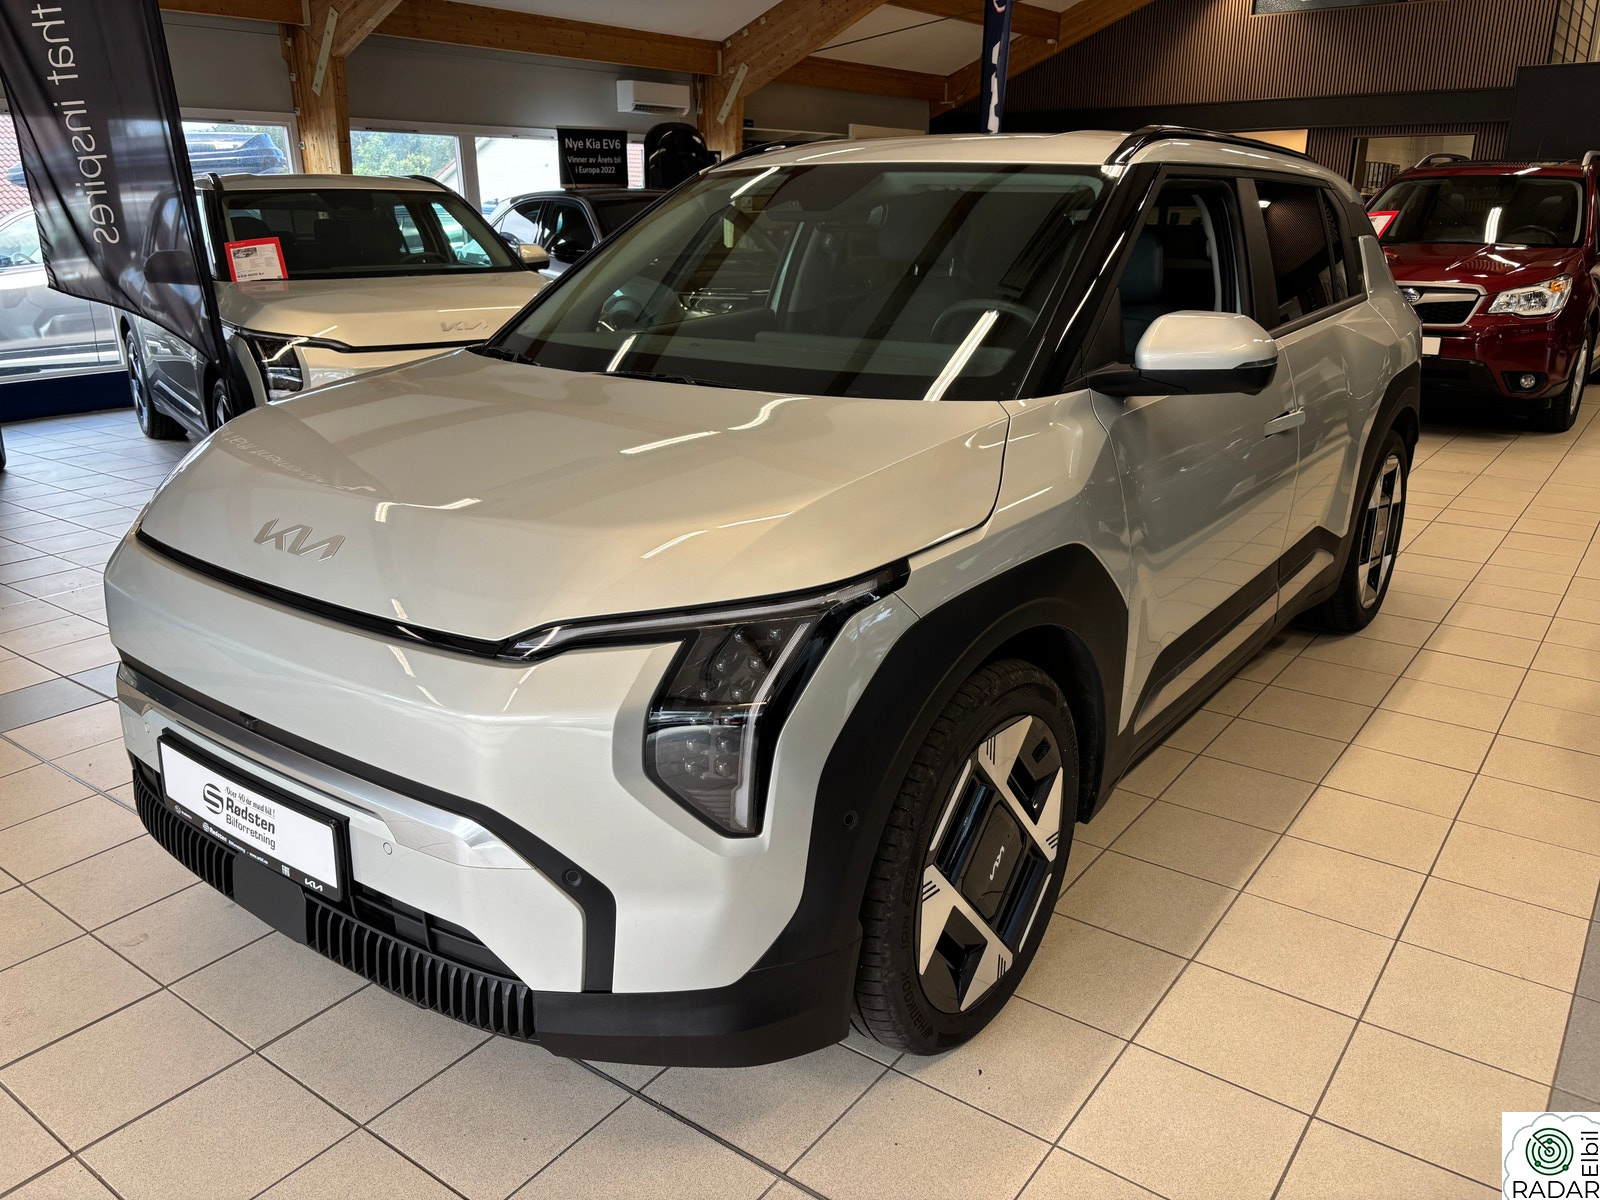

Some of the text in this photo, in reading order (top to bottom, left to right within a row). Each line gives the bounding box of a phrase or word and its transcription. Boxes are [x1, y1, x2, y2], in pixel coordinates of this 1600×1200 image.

[565, 138, 621, 151] Nye Kia EV6
[567, 154, 622, 164] Vinner av Årets bil
[579, 166, 600, 175] Europa
[600, 166, 616, 174] 2022
[440, 320, 488, 332] KIA
[253, 518, 346, 562] KIA
[238, 792, 246, 803] 40
[246, 797, 252, 805] år
[252, 802, 265, 812] med
[226, 796, 276, 835] Rødsten
[226, 814, 276, 851] Bilforretning
[304, 877, 323, 892] KIA
